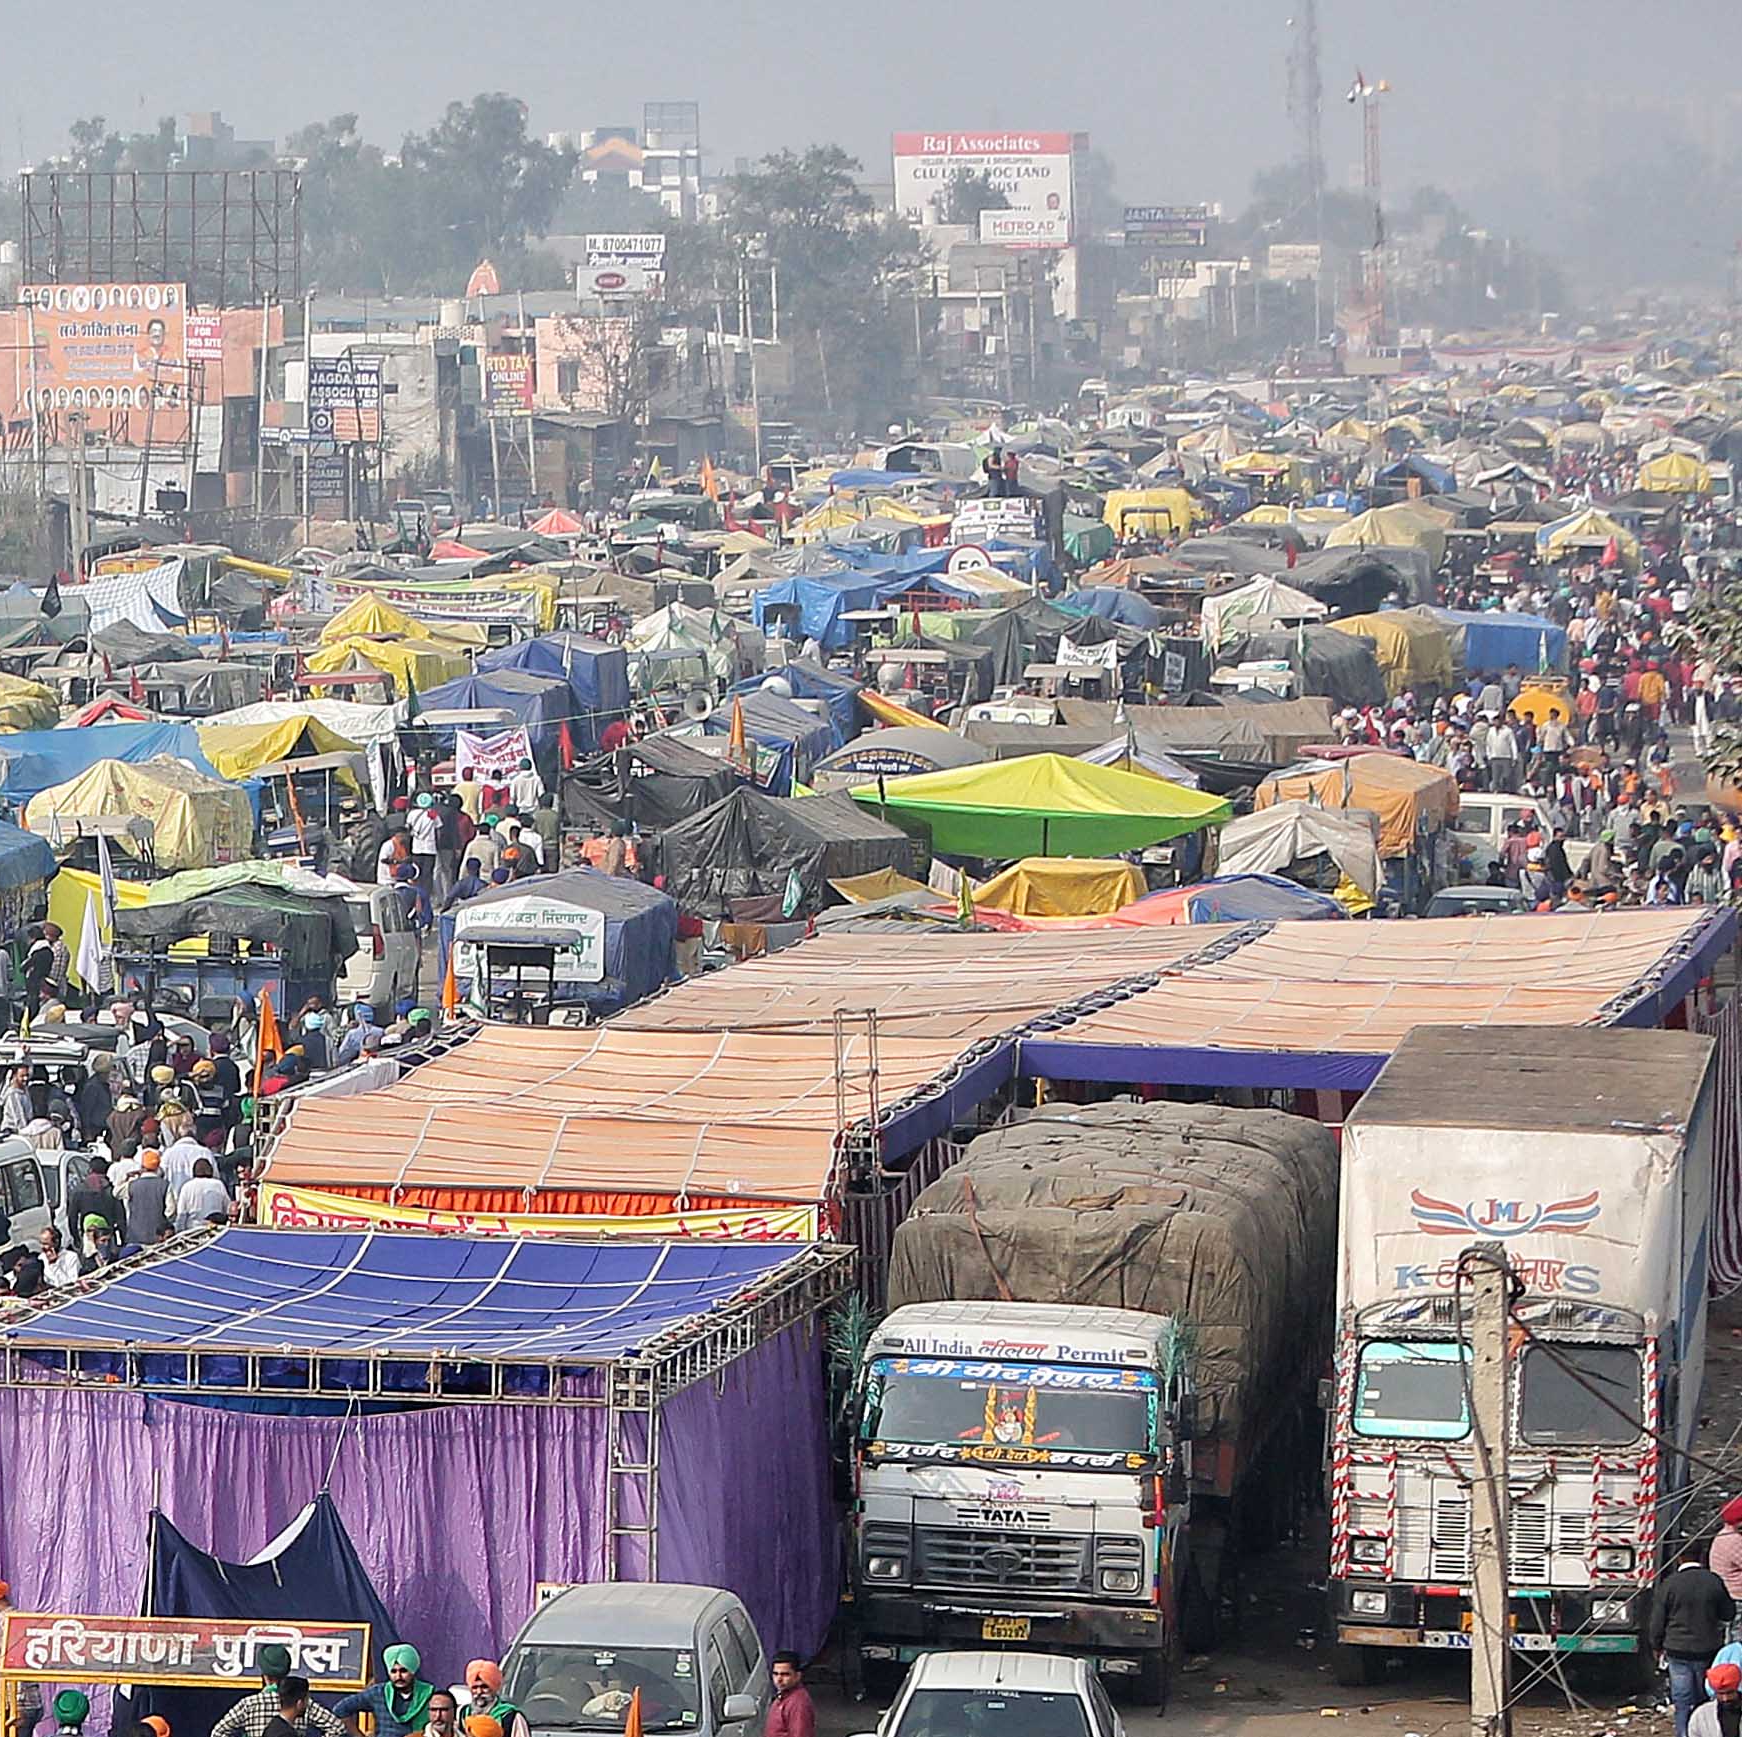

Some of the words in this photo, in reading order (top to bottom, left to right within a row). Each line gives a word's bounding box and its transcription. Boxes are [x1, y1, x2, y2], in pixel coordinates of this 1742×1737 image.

[923, 137, 954, 154] Raj
[957, 136, 1040, 151] Associates
[1016, 167, 1051, 179] LAND
[992, 220, 1034, 231] METRO
[1036, 220, 1055, 231] AD
[486, 357, 507, 372] RTO
[511, 356, 530, 371] TAX
[491, 372, 526, 383] ONLINE
[1479, 1199, 1530, 1225] JML
[1393, 1264, 1433, 1290] K
[1566, 1265, 1601, 1295] S
[903, 1337, 927, 1354] All
[932, 1338, 973, 1355] India
[1057, 1345, 1127, 1364] Permit
[909, 1360, 956, 1377] श्री
[982, 1510, 1025, 1523] TATA
[24, 1619, 200, 1670] हरियाणा
[1447, 1633, 1526, 1648] INN
